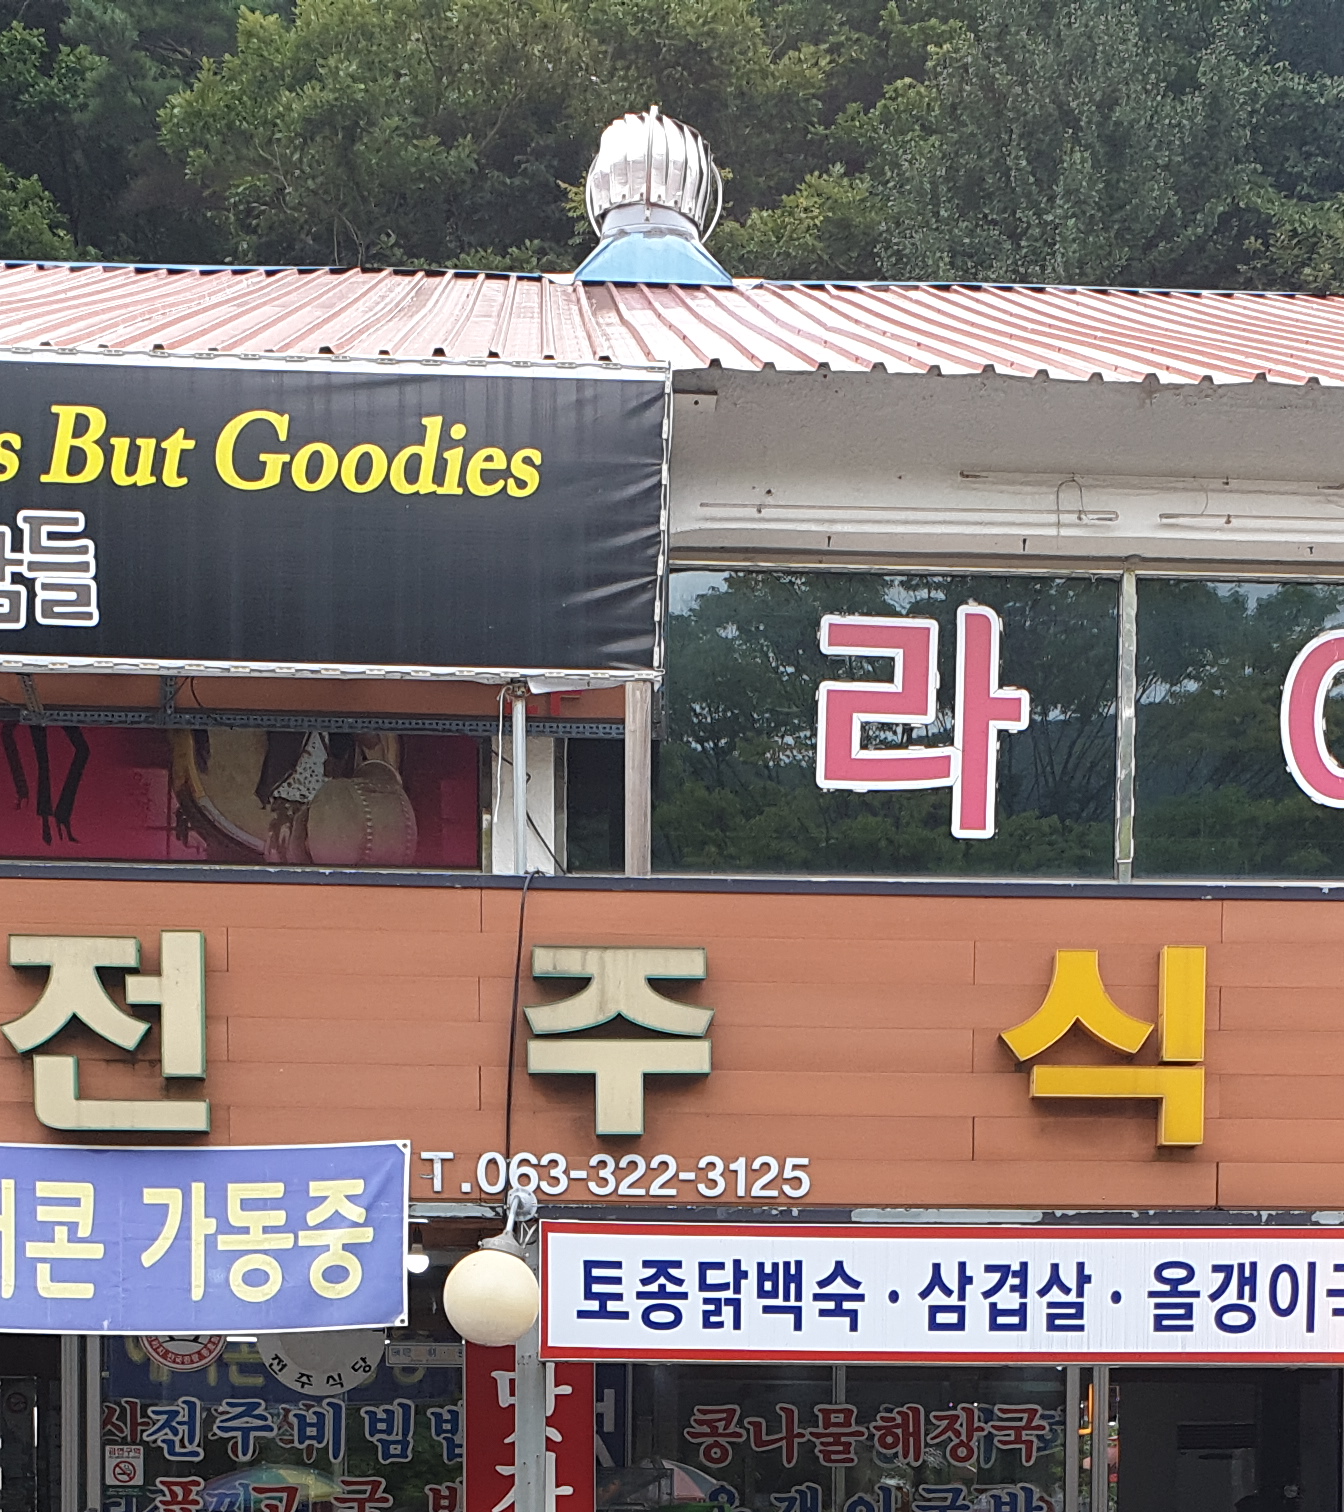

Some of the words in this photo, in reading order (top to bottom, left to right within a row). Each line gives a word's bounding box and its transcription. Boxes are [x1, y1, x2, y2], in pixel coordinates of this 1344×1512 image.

[40, 403, 196, 489] But
[215, 410, 543, 499] Goodies
[421, 1150, 812, 1200] T.063-322-3125
[139, 1175, 376, 1306] 가동중
[684, 1401, 1051, 1468] 콩나물해장국
